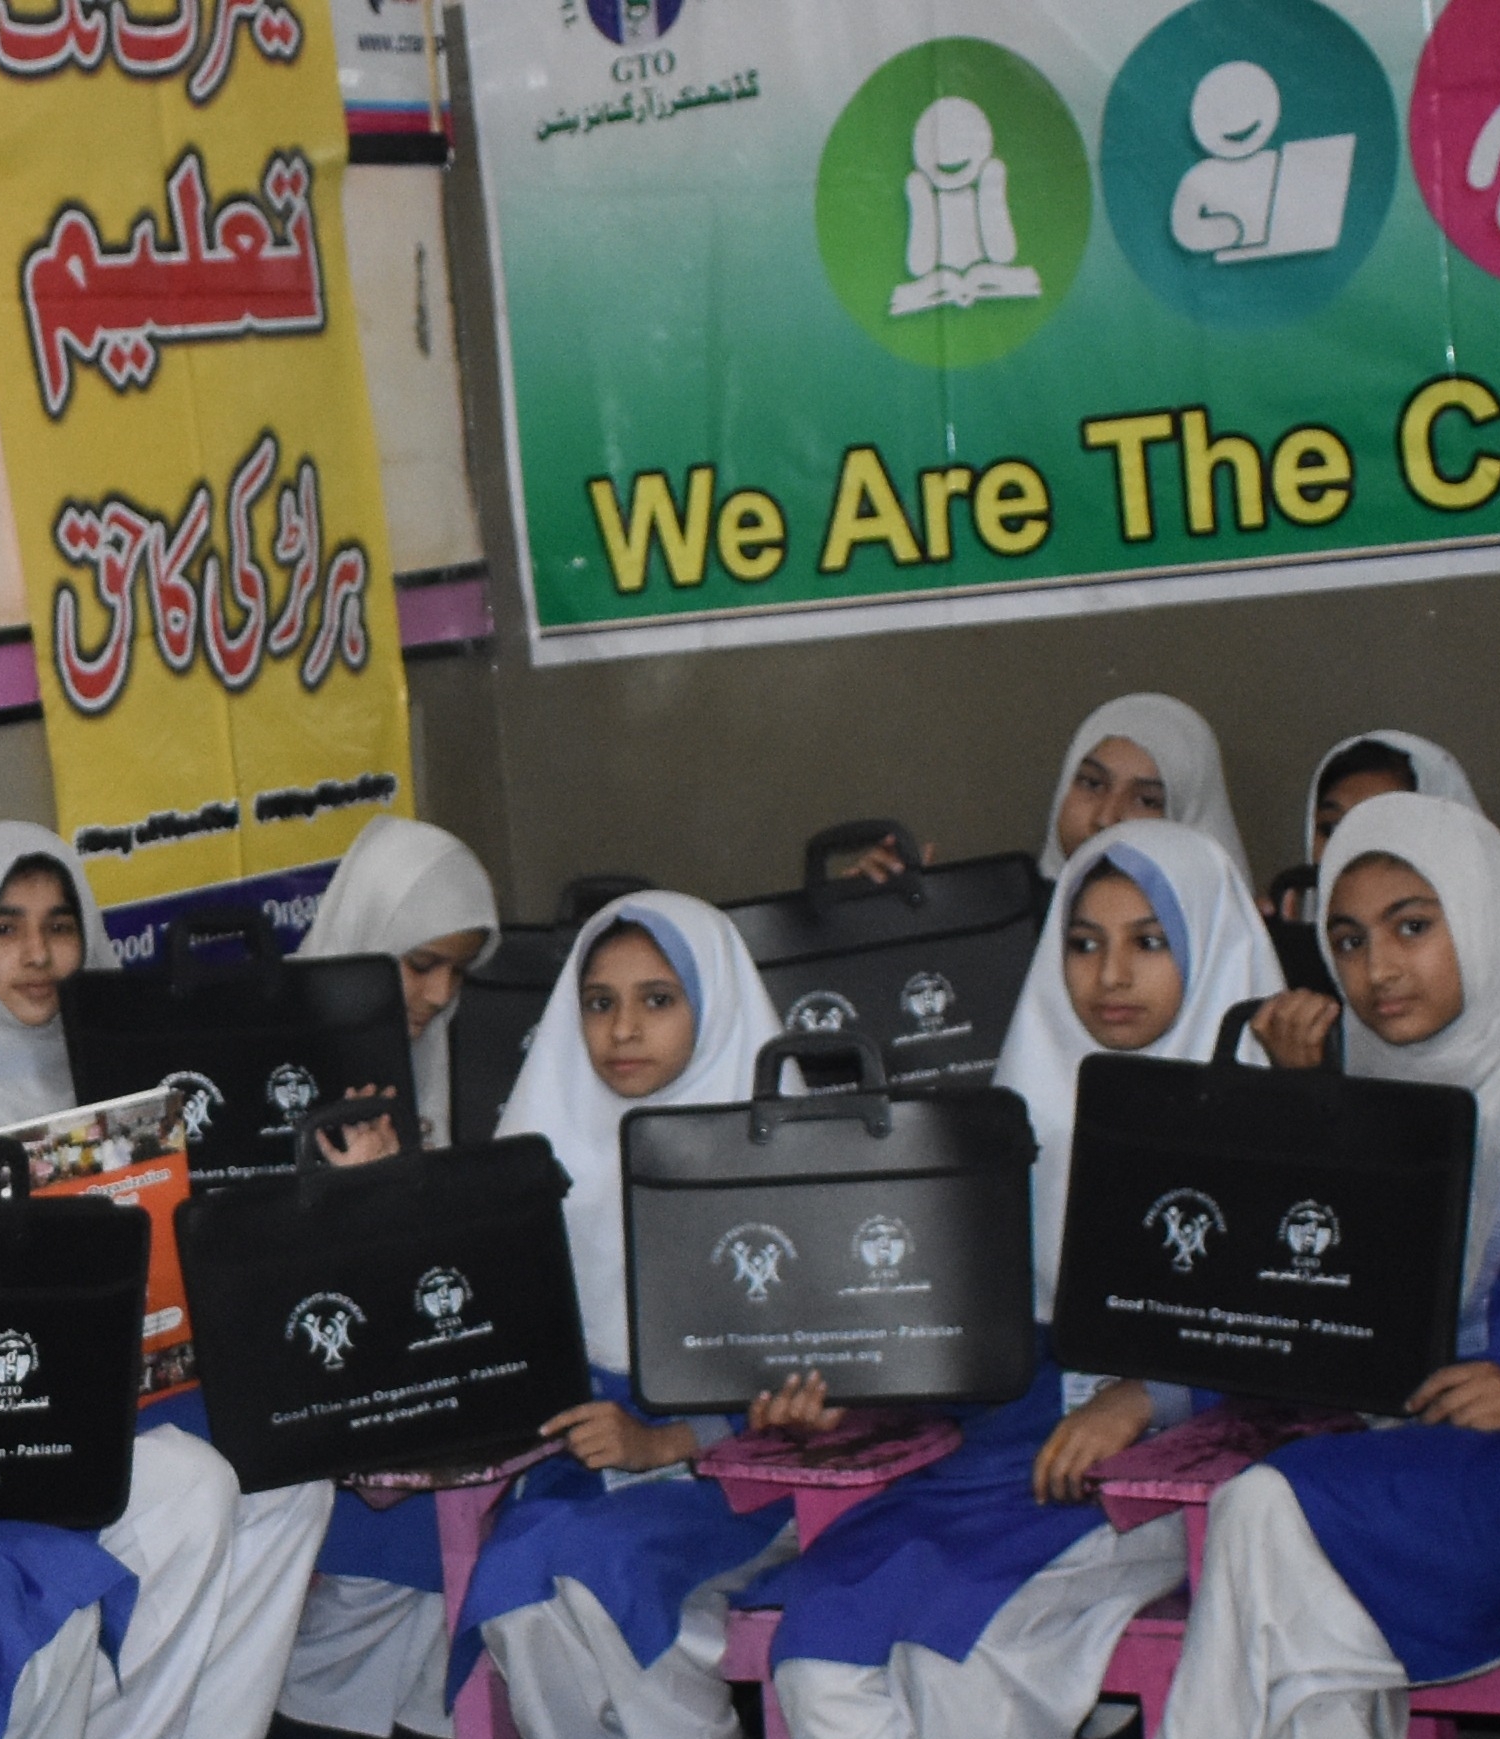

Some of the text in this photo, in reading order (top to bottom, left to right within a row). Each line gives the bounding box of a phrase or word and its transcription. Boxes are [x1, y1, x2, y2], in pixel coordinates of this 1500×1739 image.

[611, 49, 676, 83] GTO
[22, 144, 326, 424] تعلیم
[589, 464, 786, 594] We
[818, 444, 1052, 576] Are
[1080, 402, 1355, 542] The
[112, 923, 156, 962] ood
[311, 1393, 372, 1417] Thiners
[16, 1441, 73, 1458] Pakistan
